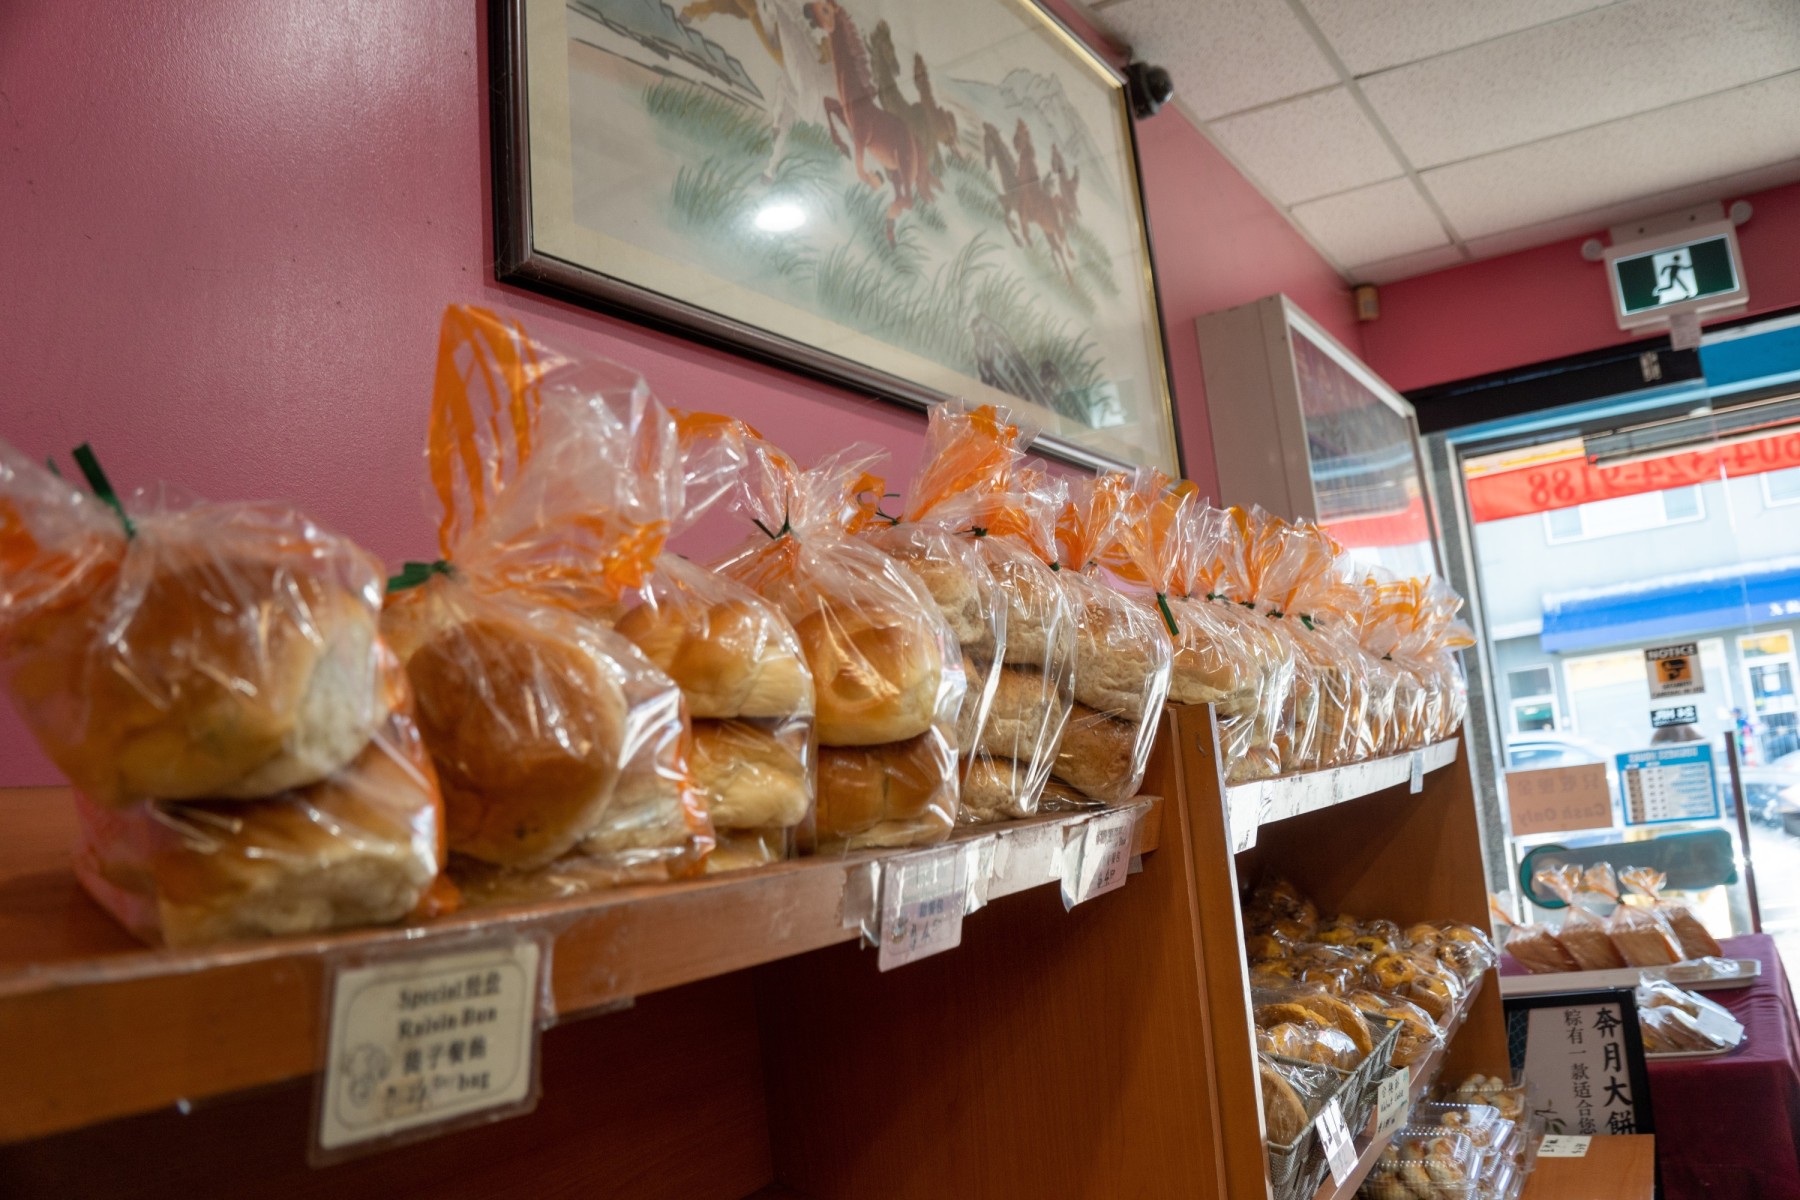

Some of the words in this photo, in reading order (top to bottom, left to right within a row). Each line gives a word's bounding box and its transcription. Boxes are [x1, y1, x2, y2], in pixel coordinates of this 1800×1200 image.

[1648, 645, 1695, 659] NOTICE
[400, 980, 462, 1012] Special
[399, 1013, 458, 1039] Raisin
[462, 1007, 498, 1028] Bun
